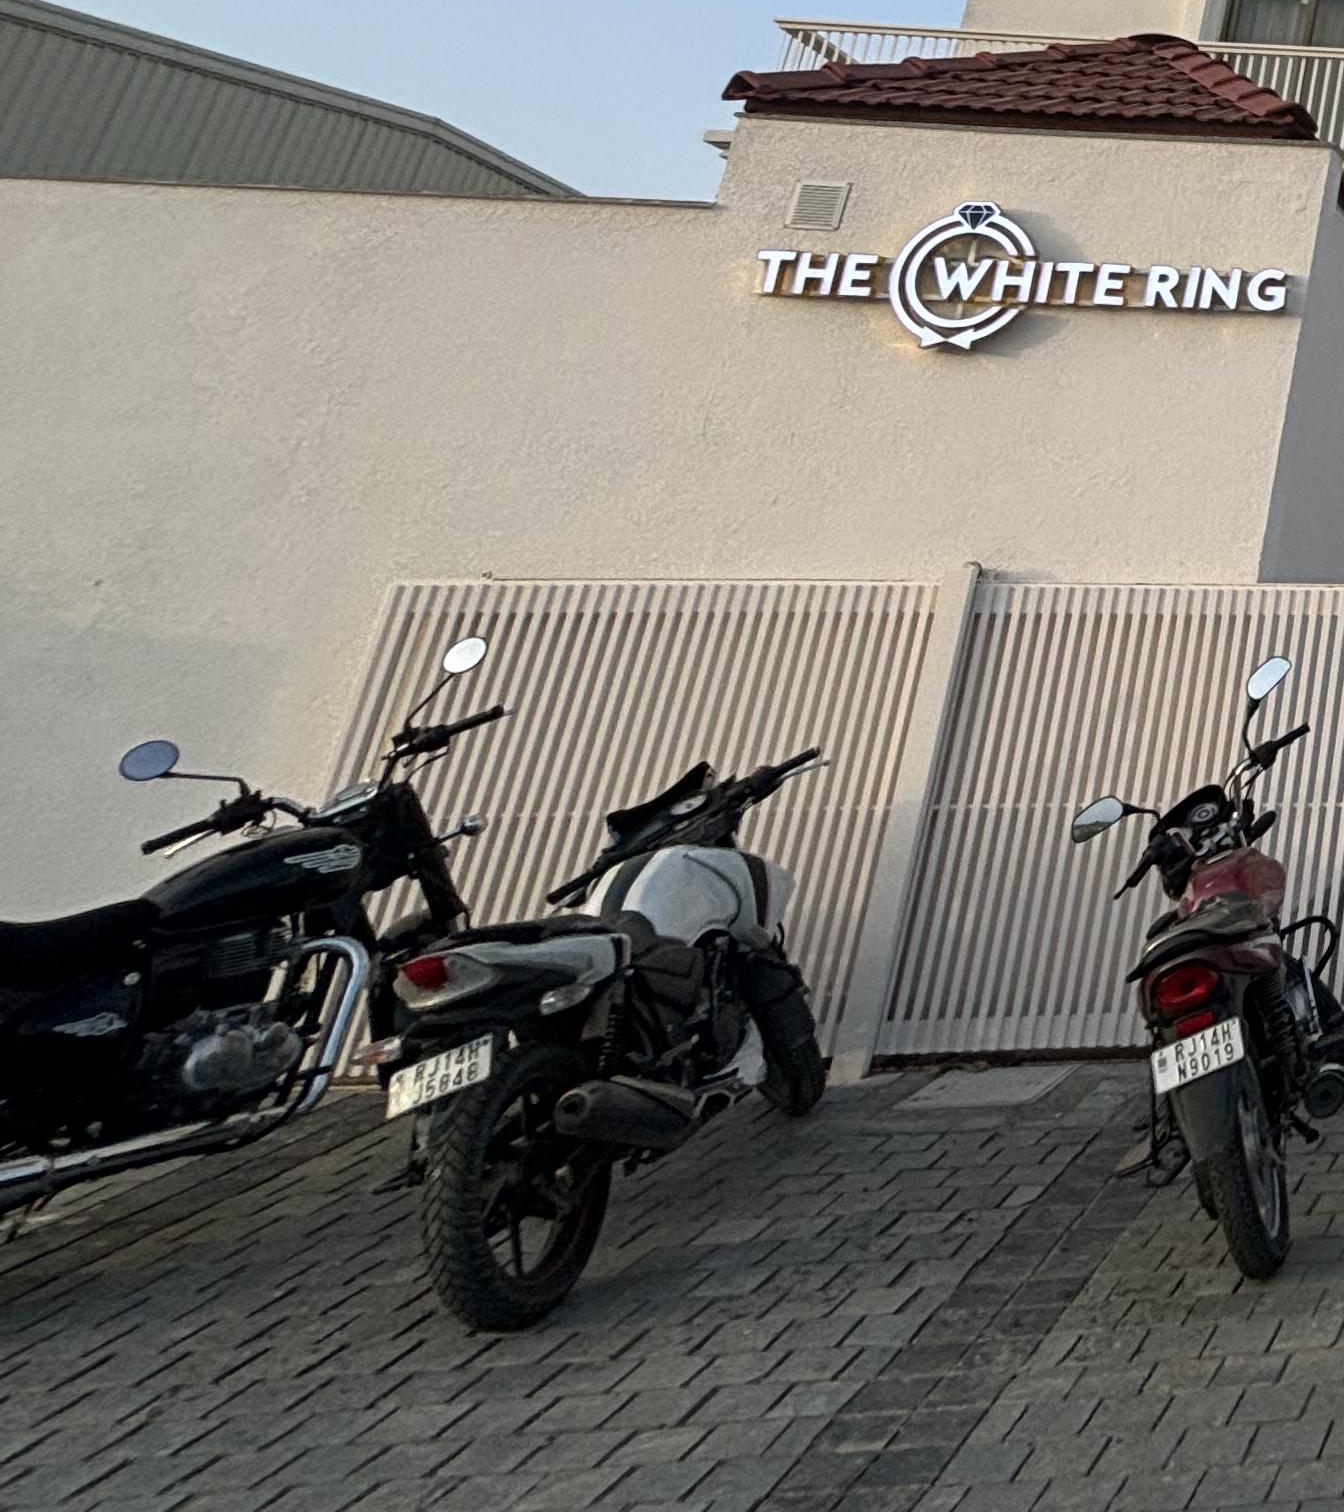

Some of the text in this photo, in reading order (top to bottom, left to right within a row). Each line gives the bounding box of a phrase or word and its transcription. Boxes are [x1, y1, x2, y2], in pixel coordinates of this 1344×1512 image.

[757, 249, 1286, 312] THE WHITE RING
[1174, 1022, 1232, 1063] RJ14H
